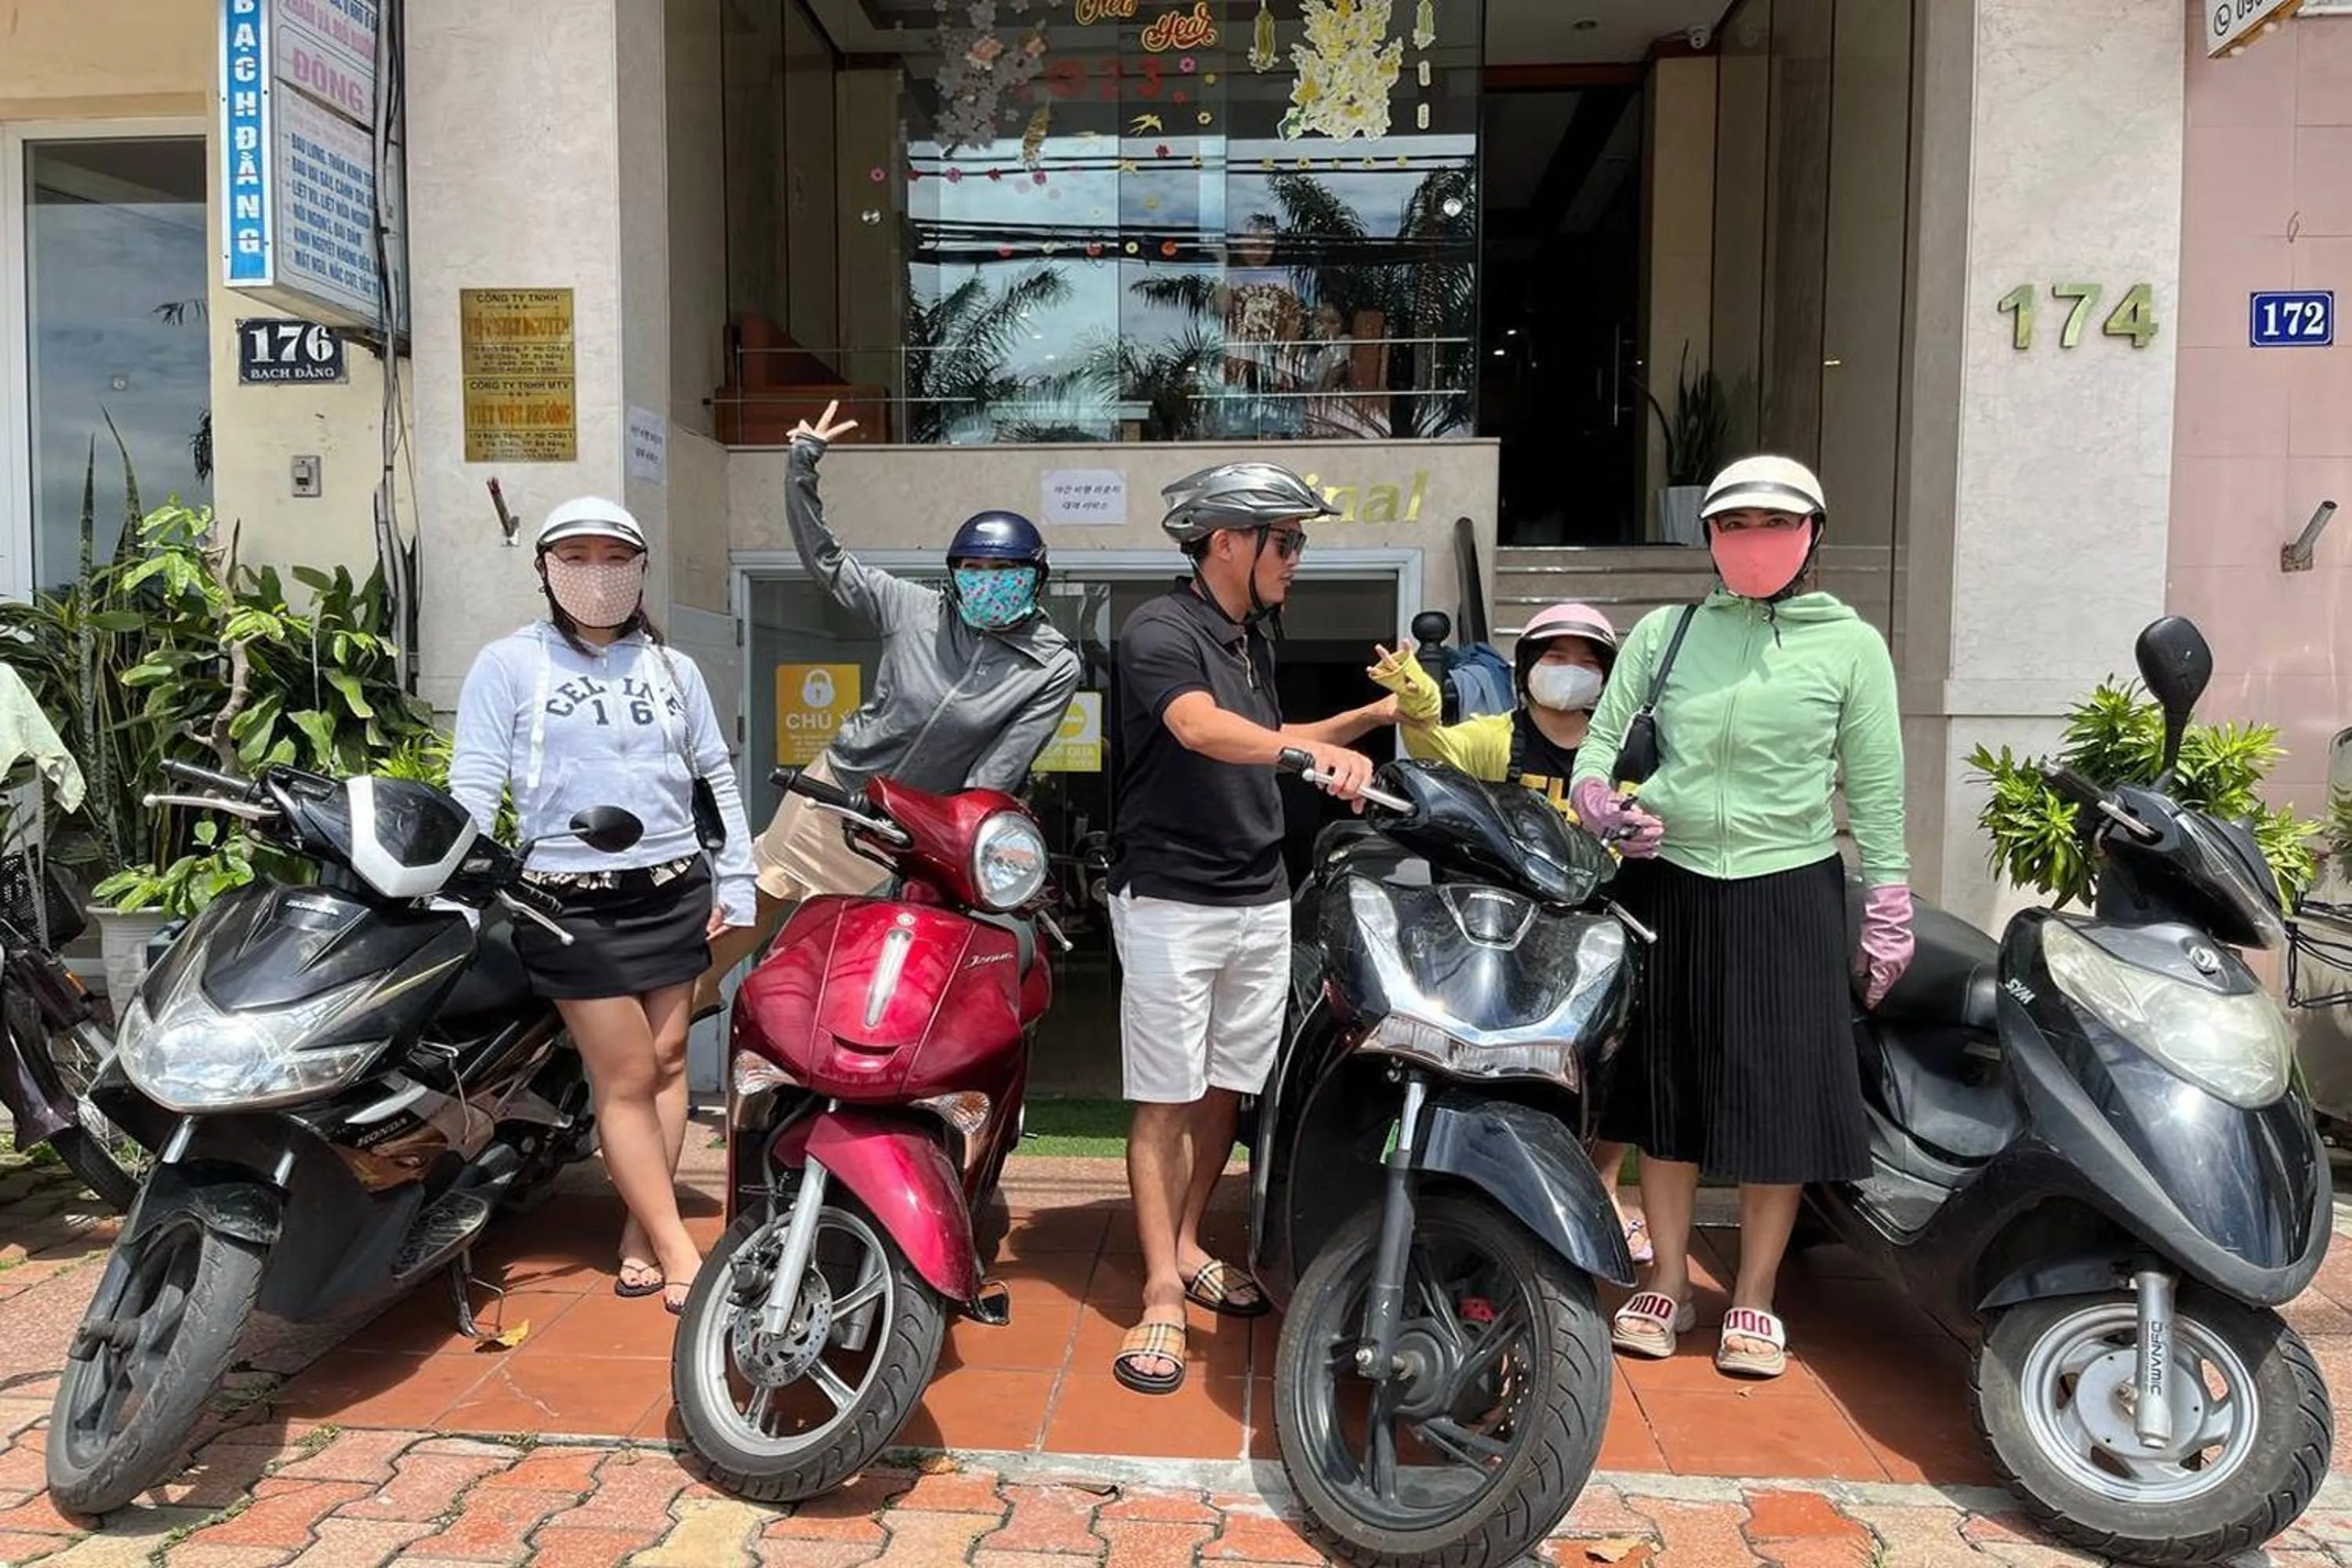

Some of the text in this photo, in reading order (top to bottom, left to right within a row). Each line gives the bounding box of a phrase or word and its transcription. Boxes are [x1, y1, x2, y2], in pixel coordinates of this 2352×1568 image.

[1142, 2, 1218, 53] Year
[1998, 283, 2159, 350] 174
[2262, 301, 2325, 337] 172
[249, 325, 335, 363] 176
